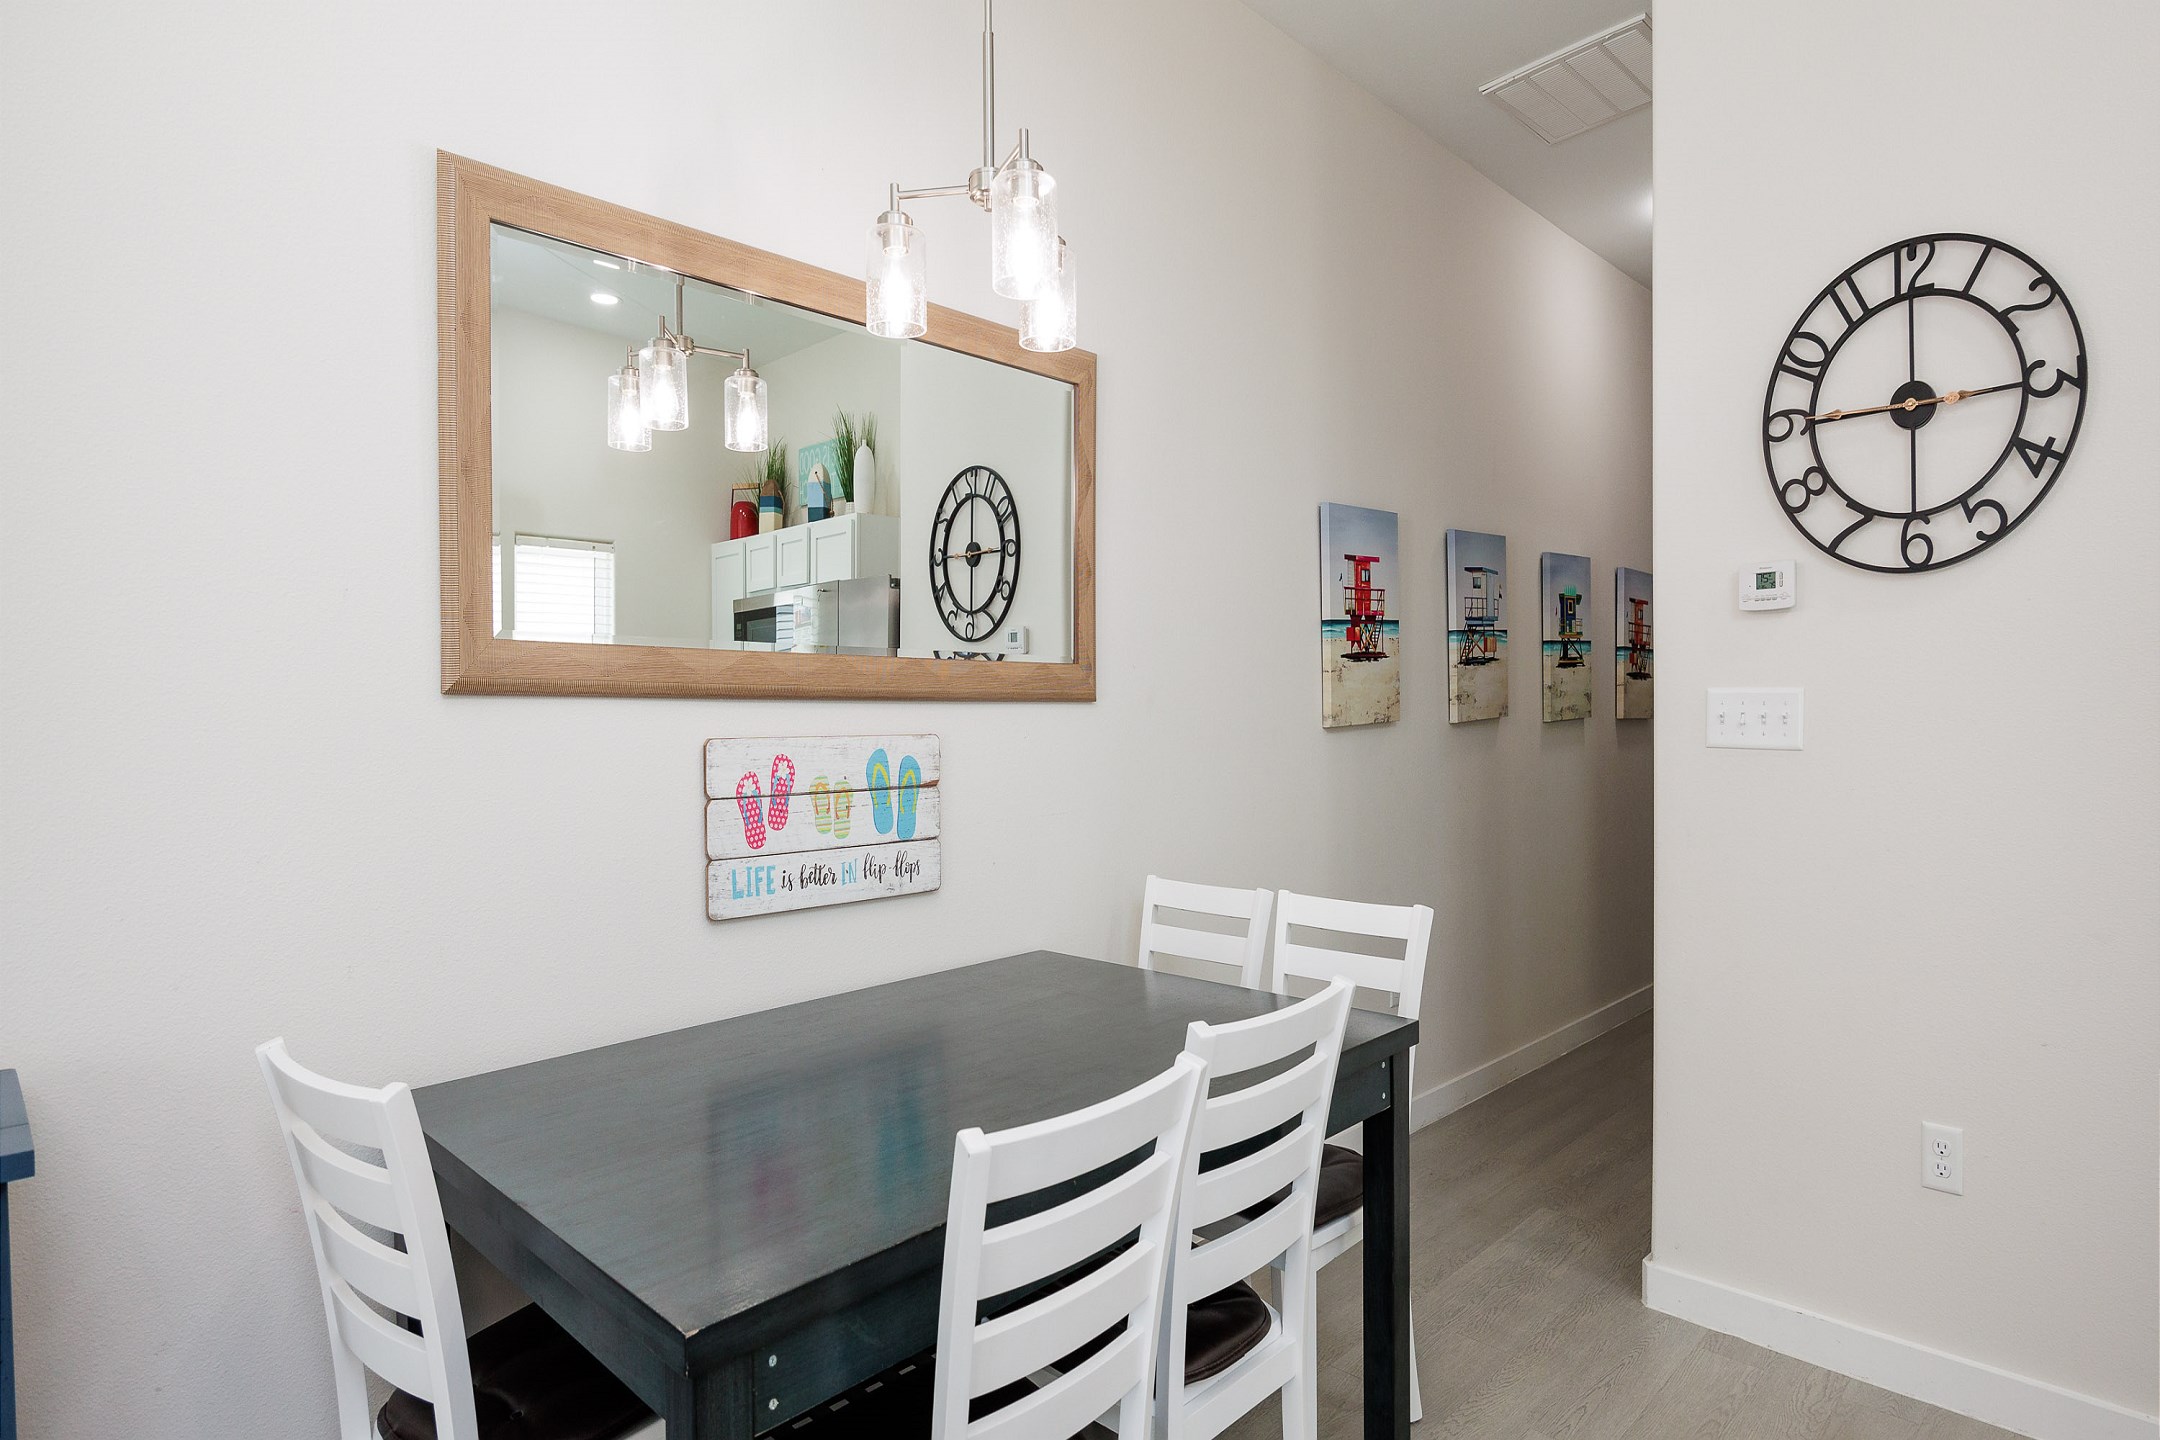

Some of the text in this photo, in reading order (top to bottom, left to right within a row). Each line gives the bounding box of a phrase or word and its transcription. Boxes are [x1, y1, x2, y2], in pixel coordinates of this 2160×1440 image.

[1894, 240, 1935, 297] 12
[1963, 243, 1993, 296] 1
[1829, 274, 1871, 327] 11
[1999, 275, 2058, 335] 2
[1778, 331, 1830, 384] 10
[2027, 355, 2083, 399] 3
[1767, 408, 1811, 443] 9
[2012, 436, 2064, 479] 4
[1780, 466, 1828, 514] 8
[1827, 500, 1874, 554] 7
[1901, 514, 1934, 569] 6
[1959, 498, 2008, 542] 5
[731, 865, 776, 900] LIFE
[781, 869, 795, 892] is
[799, 863, 838, 888] better
[841, 858, 858, 887] IN
